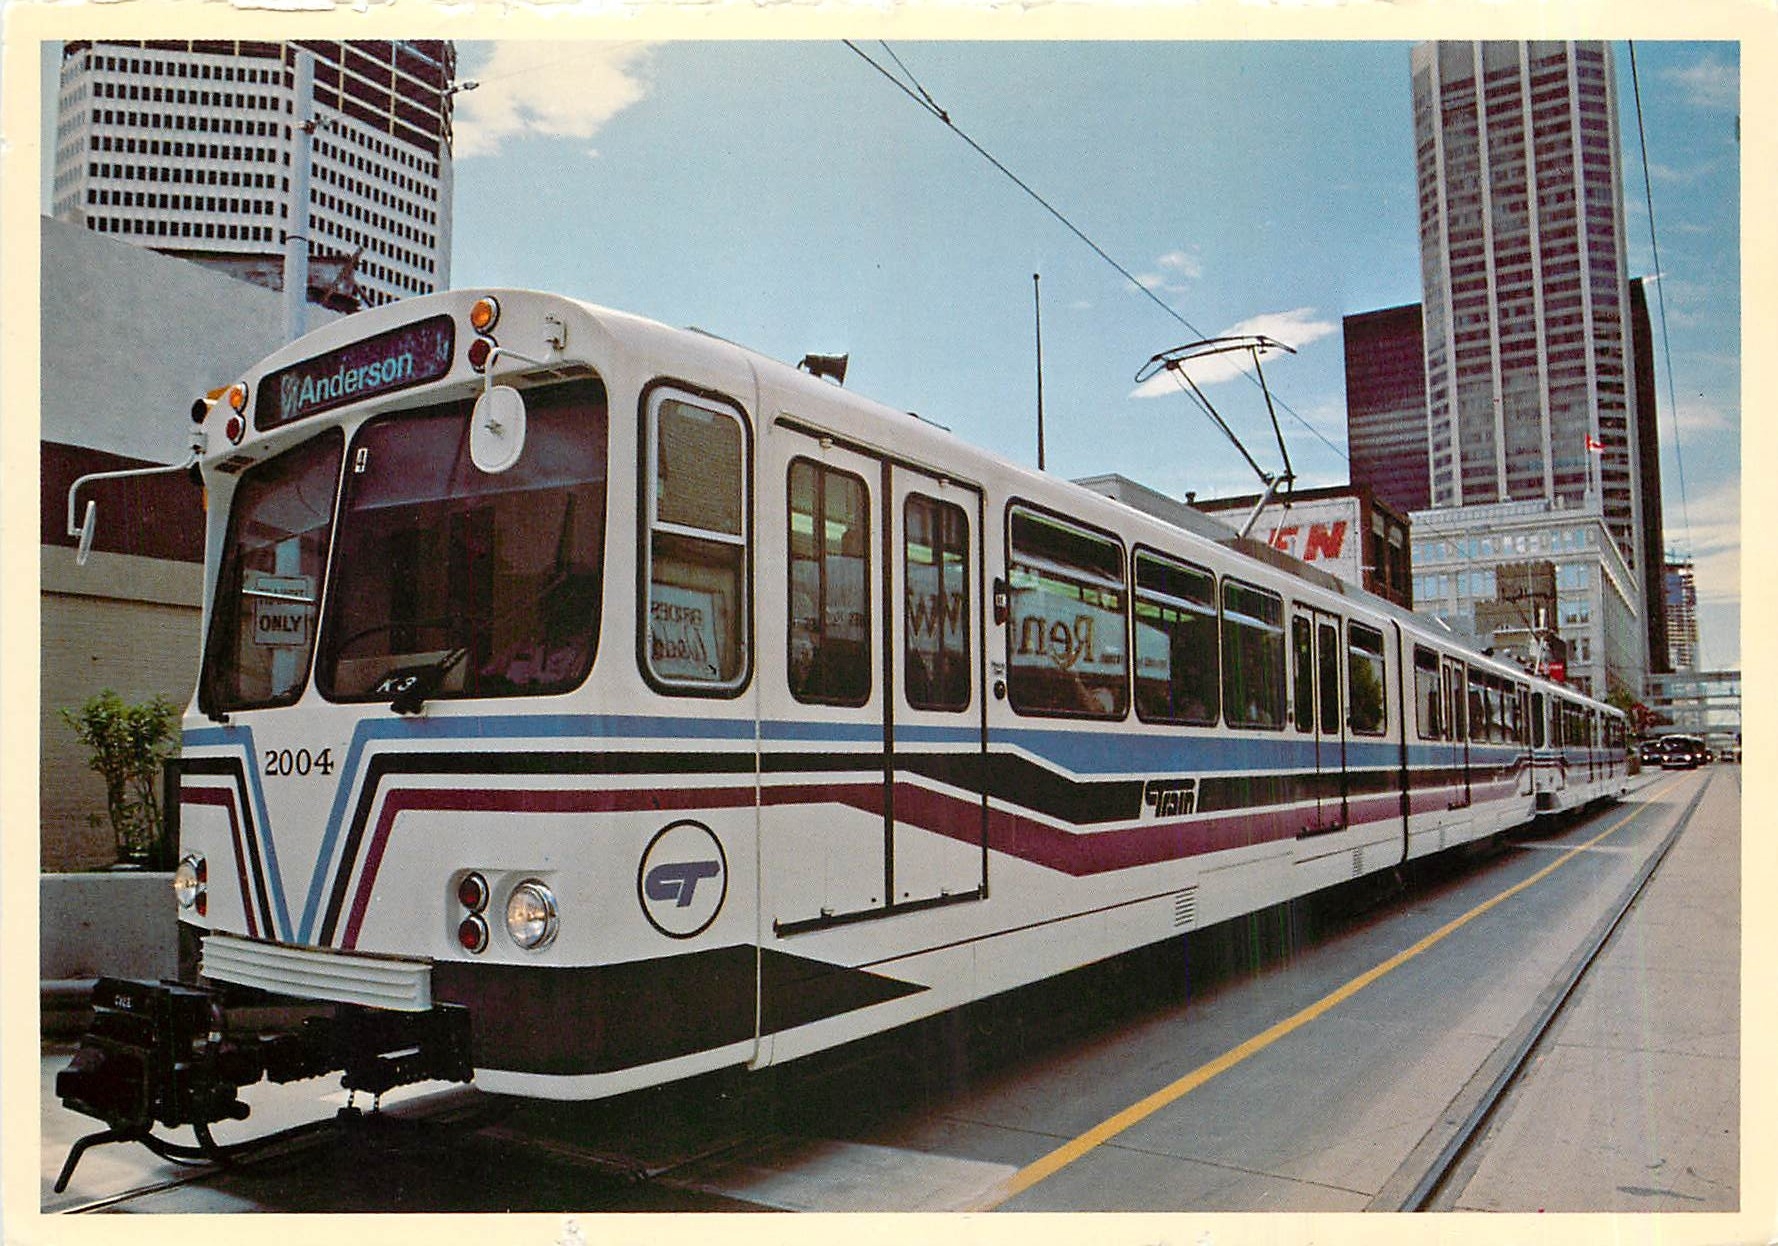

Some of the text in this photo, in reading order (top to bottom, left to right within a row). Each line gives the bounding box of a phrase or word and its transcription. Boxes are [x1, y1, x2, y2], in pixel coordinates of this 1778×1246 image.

[298, 351, 414, 409] Anderson
[259, 615, 302, 632] ONLY
[264, 747, 335, 776] 2004
